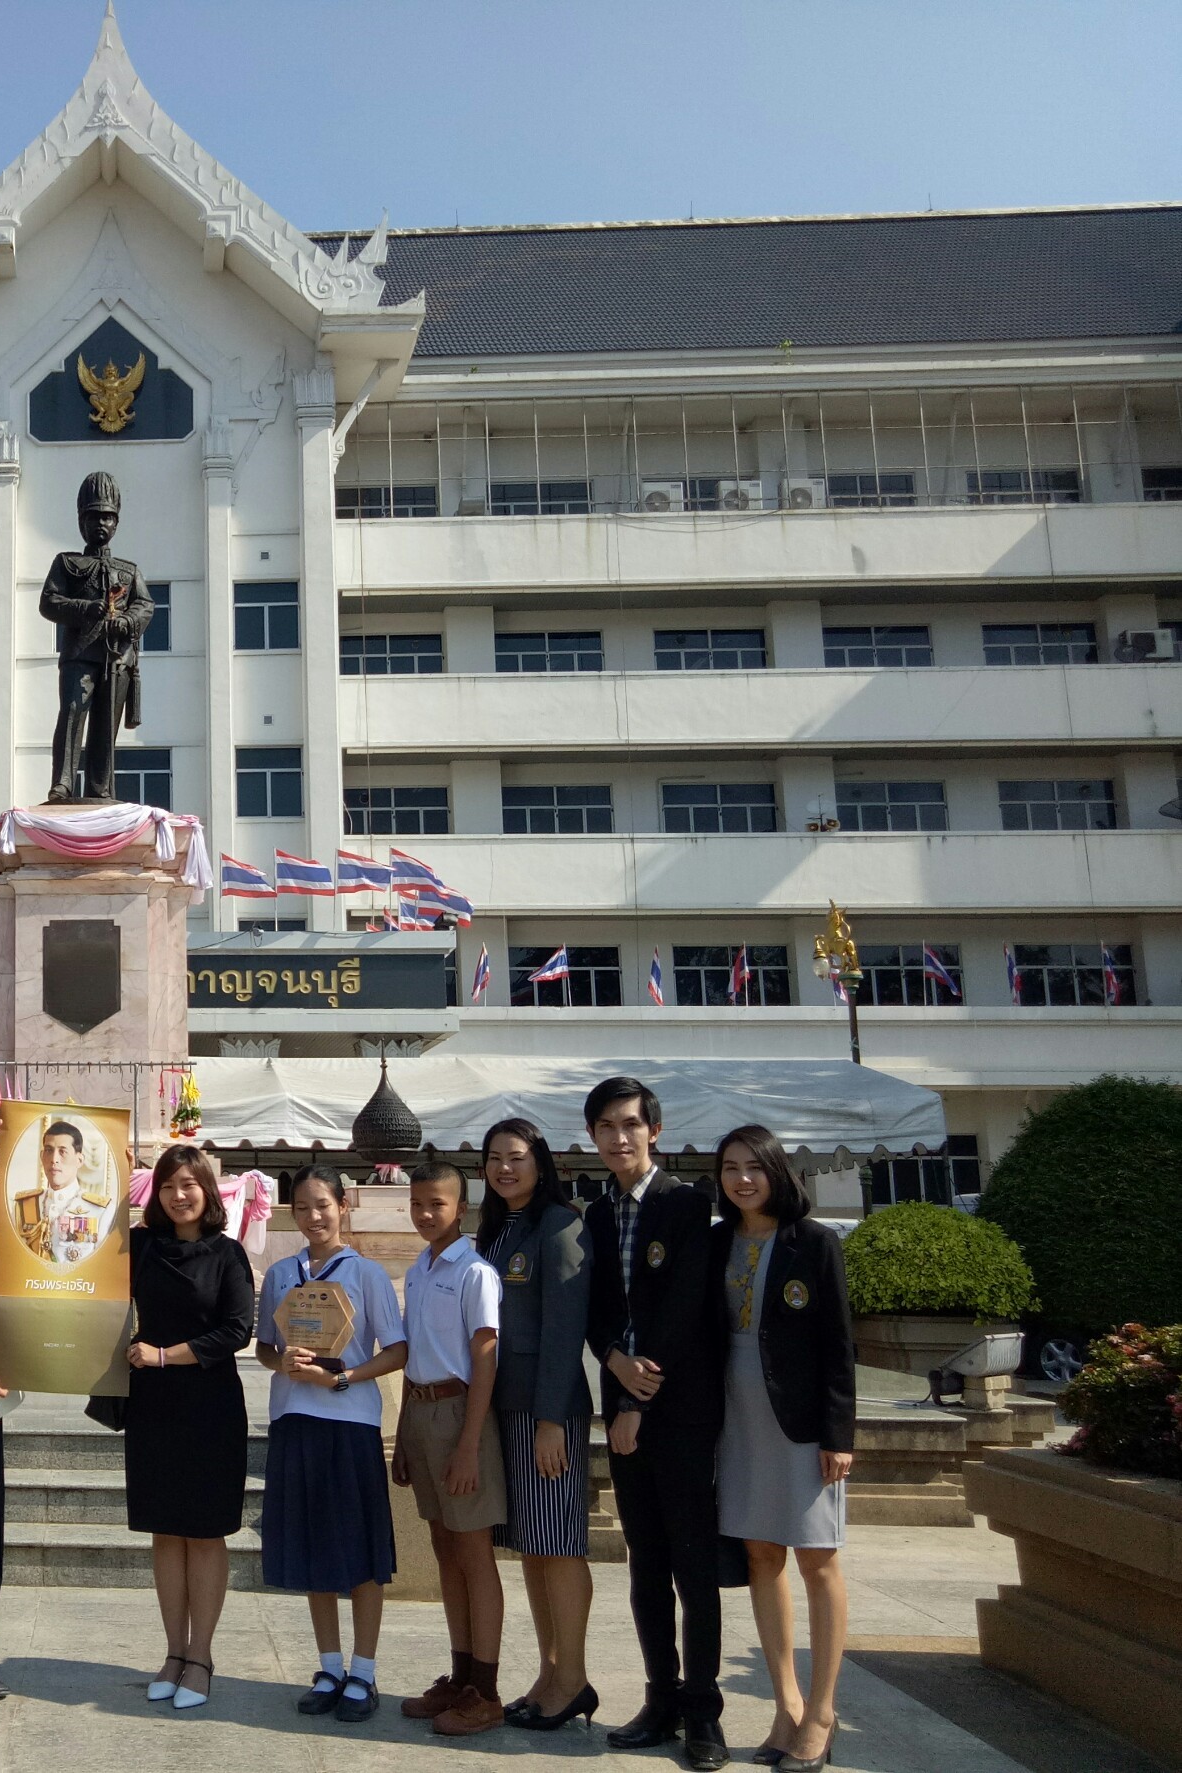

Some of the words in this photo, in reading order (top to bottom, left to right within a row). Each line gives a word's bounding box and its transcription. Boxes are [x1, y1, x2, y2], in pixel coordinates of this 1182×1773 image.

[25, 1278, 96, 1294] ทรงพระเจริญ
